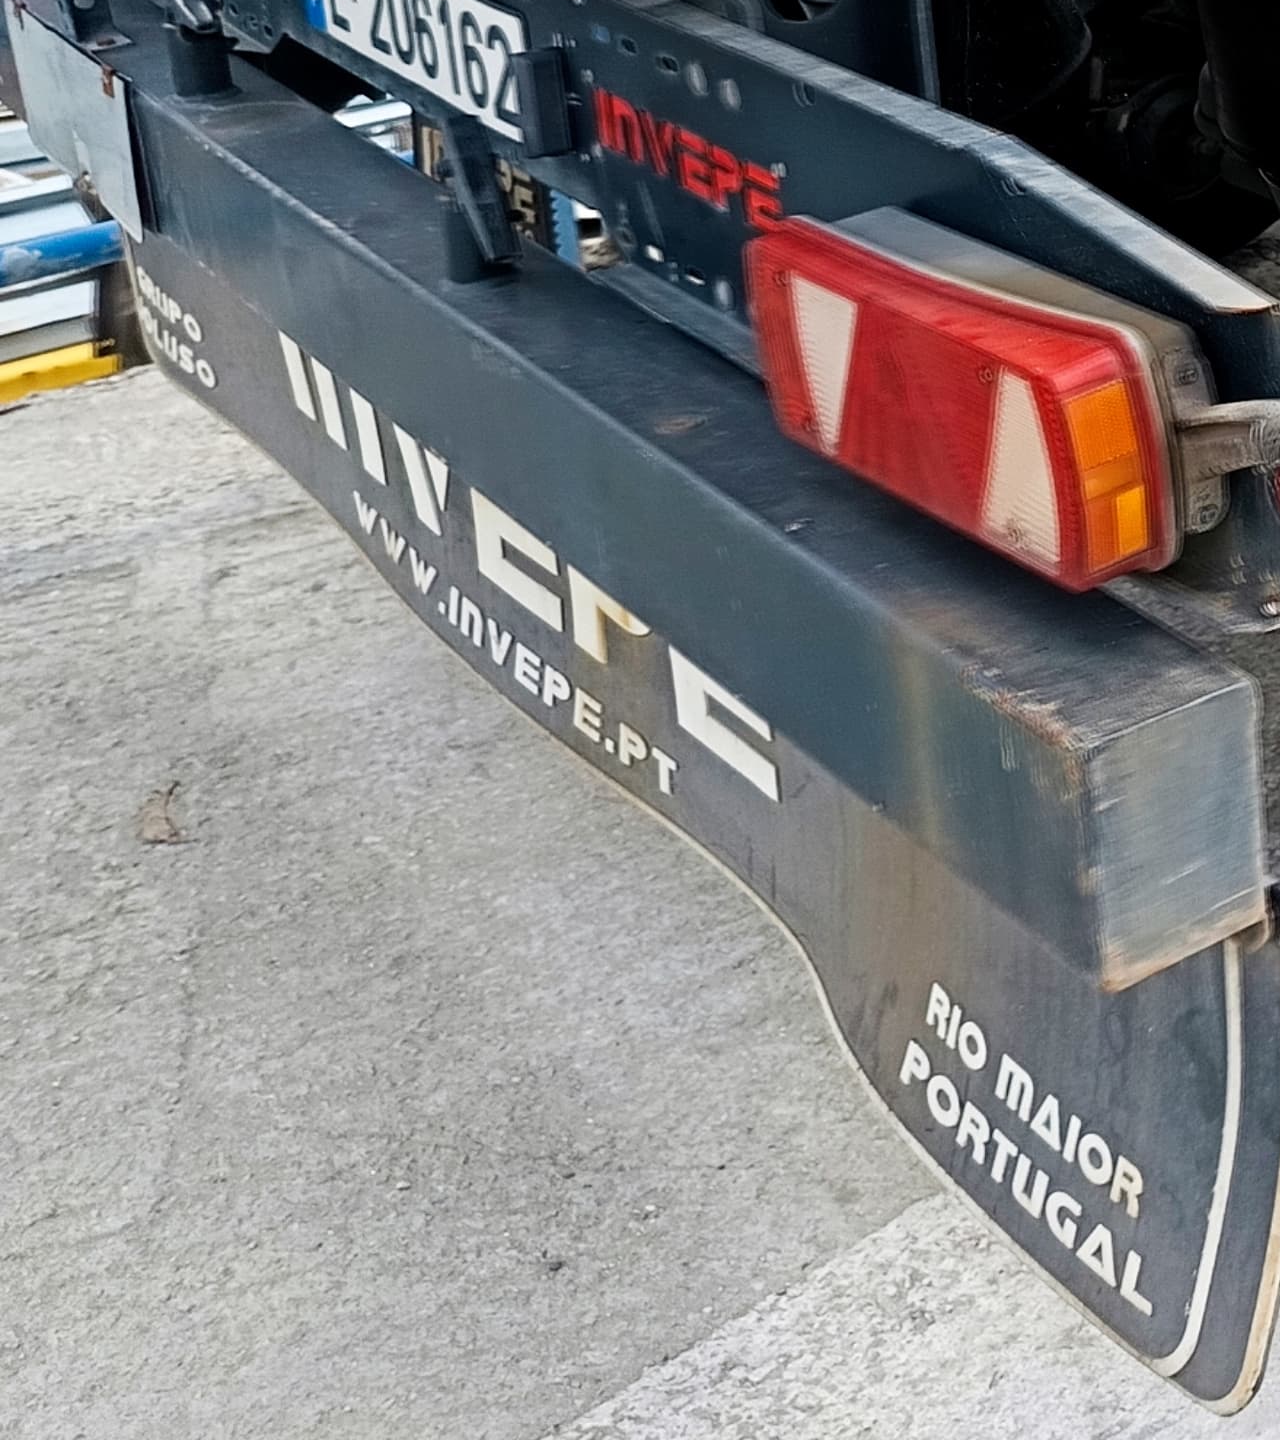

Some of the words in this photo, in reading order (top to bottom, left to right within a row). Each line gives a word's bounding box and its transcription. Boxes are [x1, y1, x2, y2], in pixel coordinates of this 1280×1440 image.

[593, 88, 785, 235] INVEPE
[352, 490, 679, 797] WWW.INVEPE.PT
[899, 1039, 1154, 1318] PORTUGAL
[925, 981, 988, 1072] RIO
[993, 1052, 1145, 1219] MAIOR
